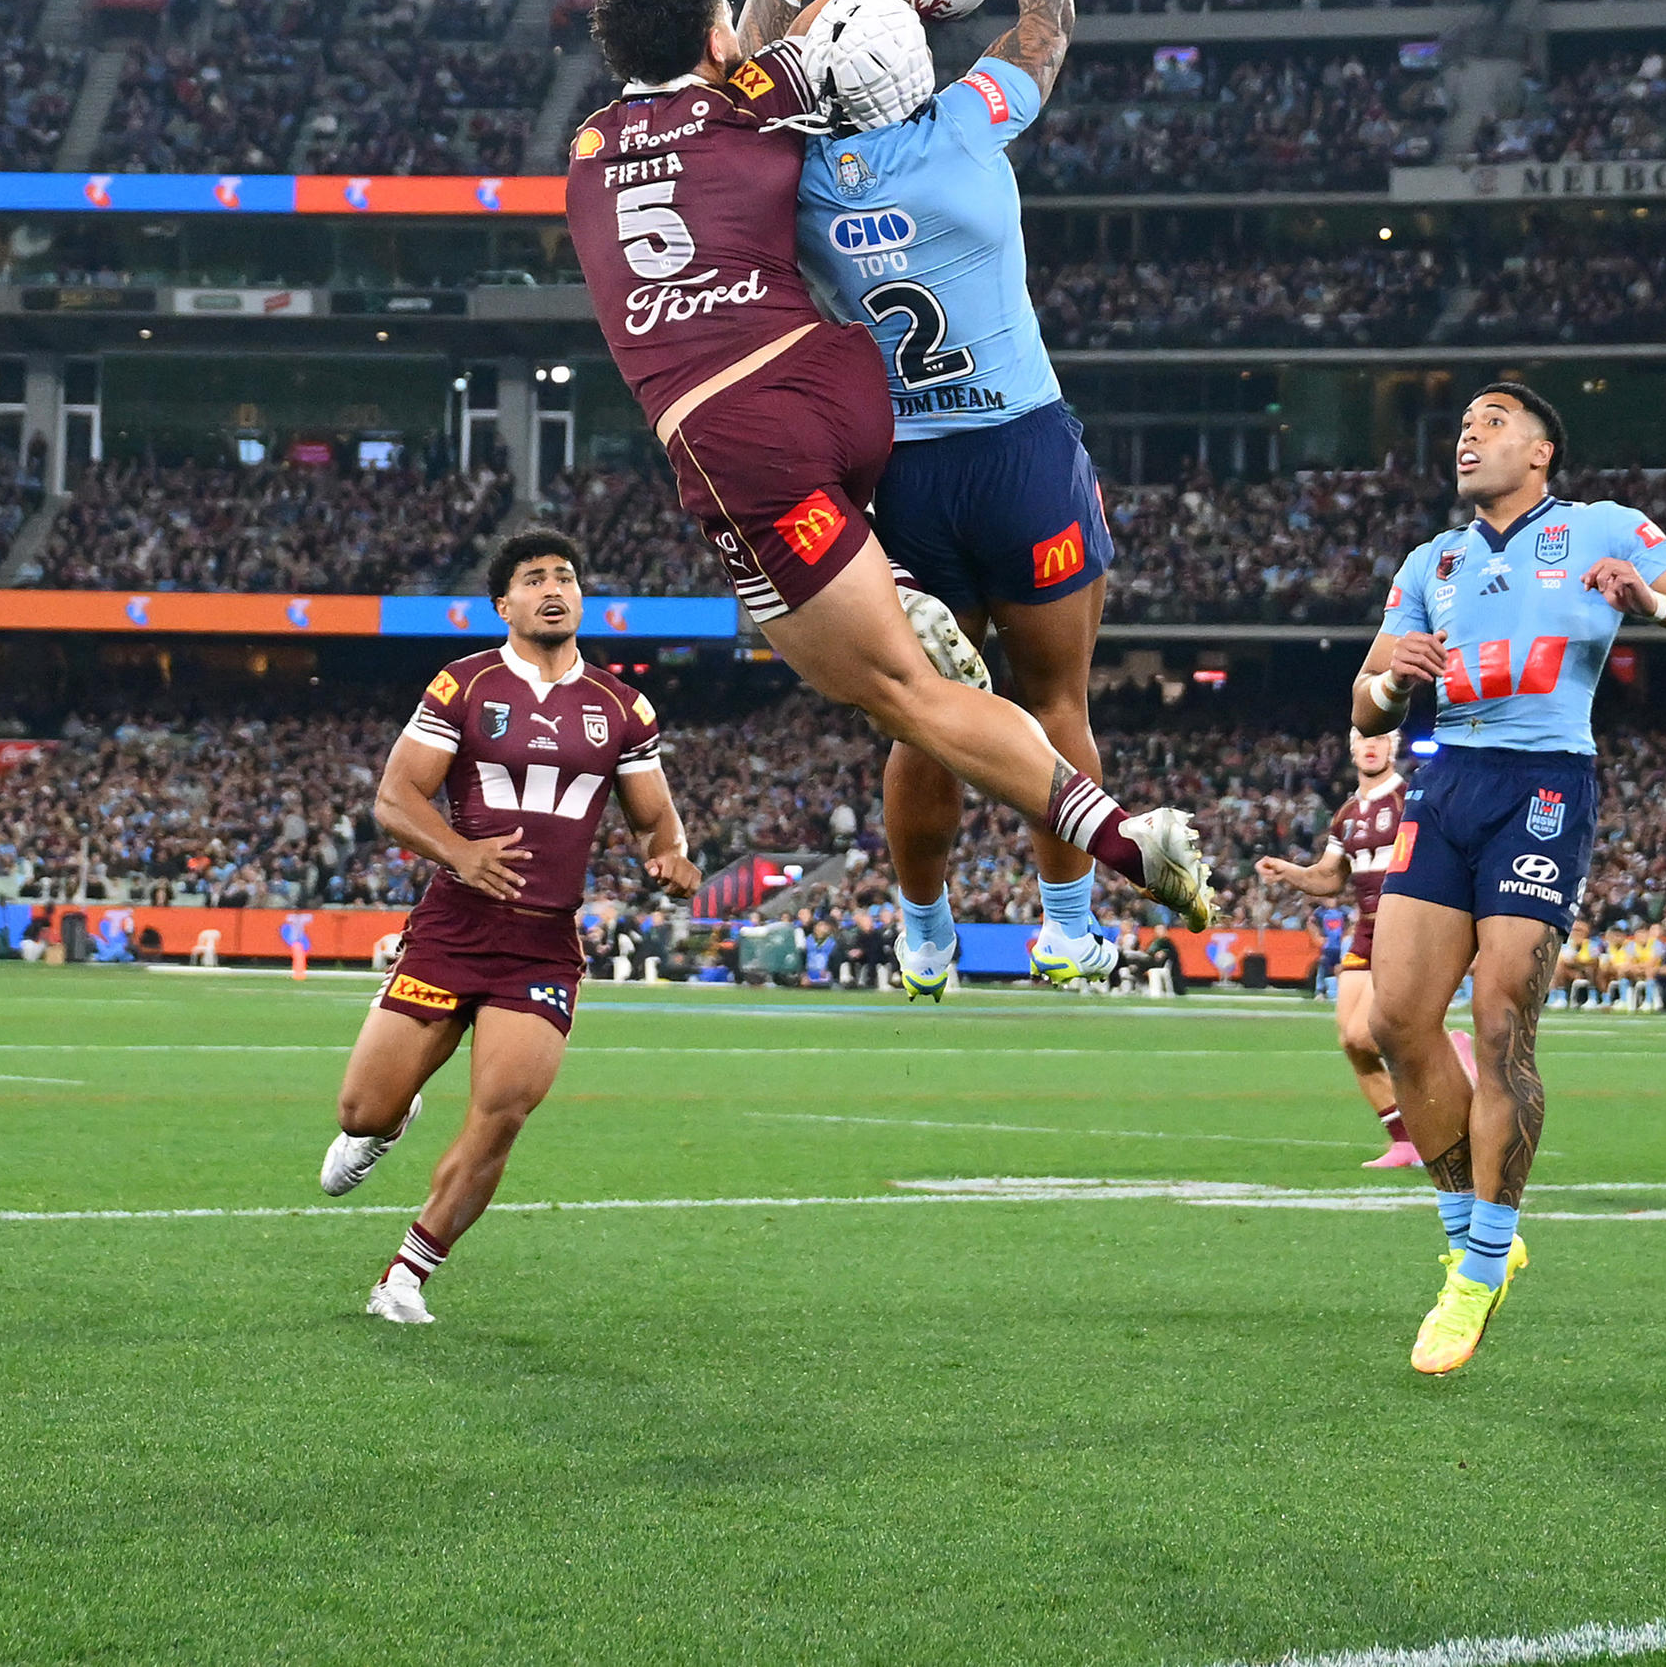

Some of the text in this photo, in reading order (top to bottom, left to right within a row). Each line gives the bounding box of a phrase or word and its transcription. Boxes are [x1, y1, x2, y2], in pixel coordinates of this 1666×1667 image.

[619, 119, 705, 153] V-Power
[604, 152, 684, 188] FIFITA
[616, 180, 696, 279] 5
[835, 213, 910, 249] GIO
[853, 250, 908, 279] TO'O
[625, 268, 768, 335] Ford
[860, 279, 976, 390] 2
[1499, 880, 1563, 905] HYUNDAI
[395, 978, 452, 1006] XXXX
